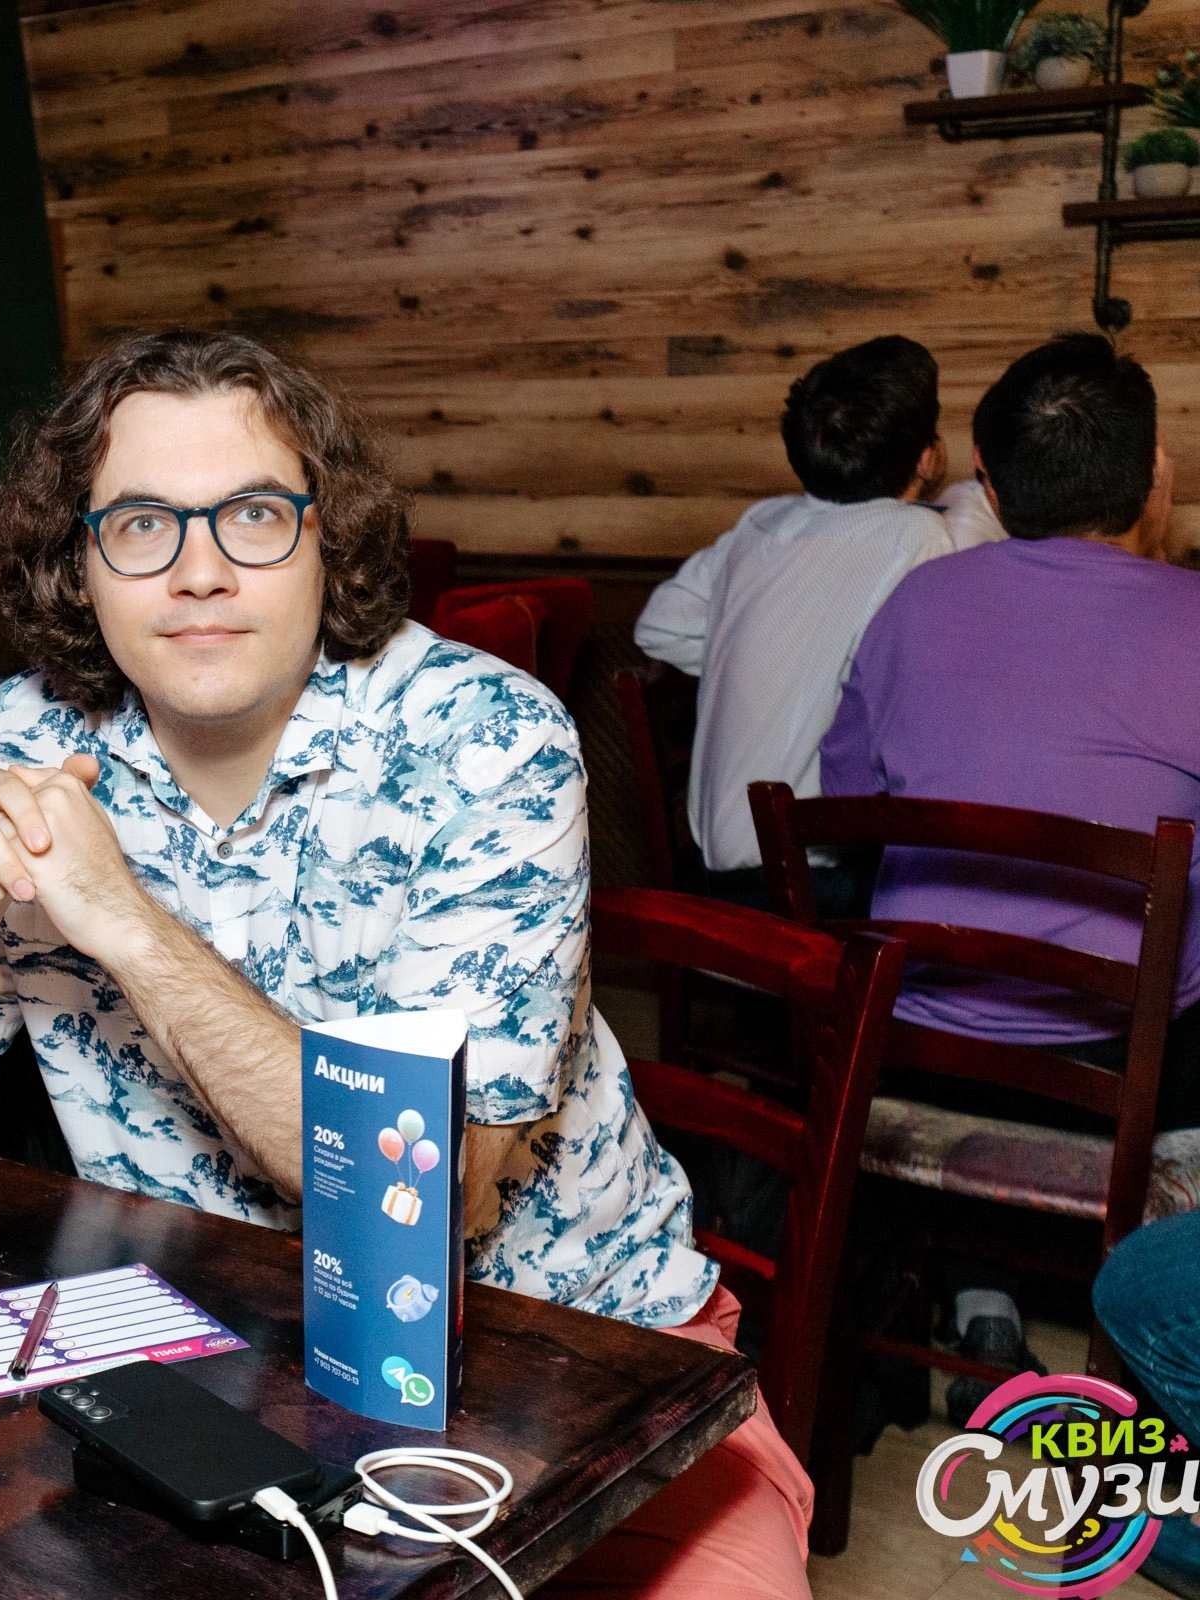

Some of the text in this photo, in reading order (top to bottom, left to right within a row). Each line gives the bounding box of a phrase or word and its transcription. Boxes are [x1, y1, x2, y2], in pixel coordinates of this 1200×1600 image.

[314, 1055, 386, 1095] Акции
[313, 1125, 345, 1150] 20%
[313, 1249, 343, 1276] 20%
[313, 1265, 333, 1281] Скидка
[318, 1286, 324, 1295] 12
[332, 1293, 338, 1301] 17
[338, 1298, 357, 1310] часов
[150, 1345, 193, 1358] БЛИЦ
